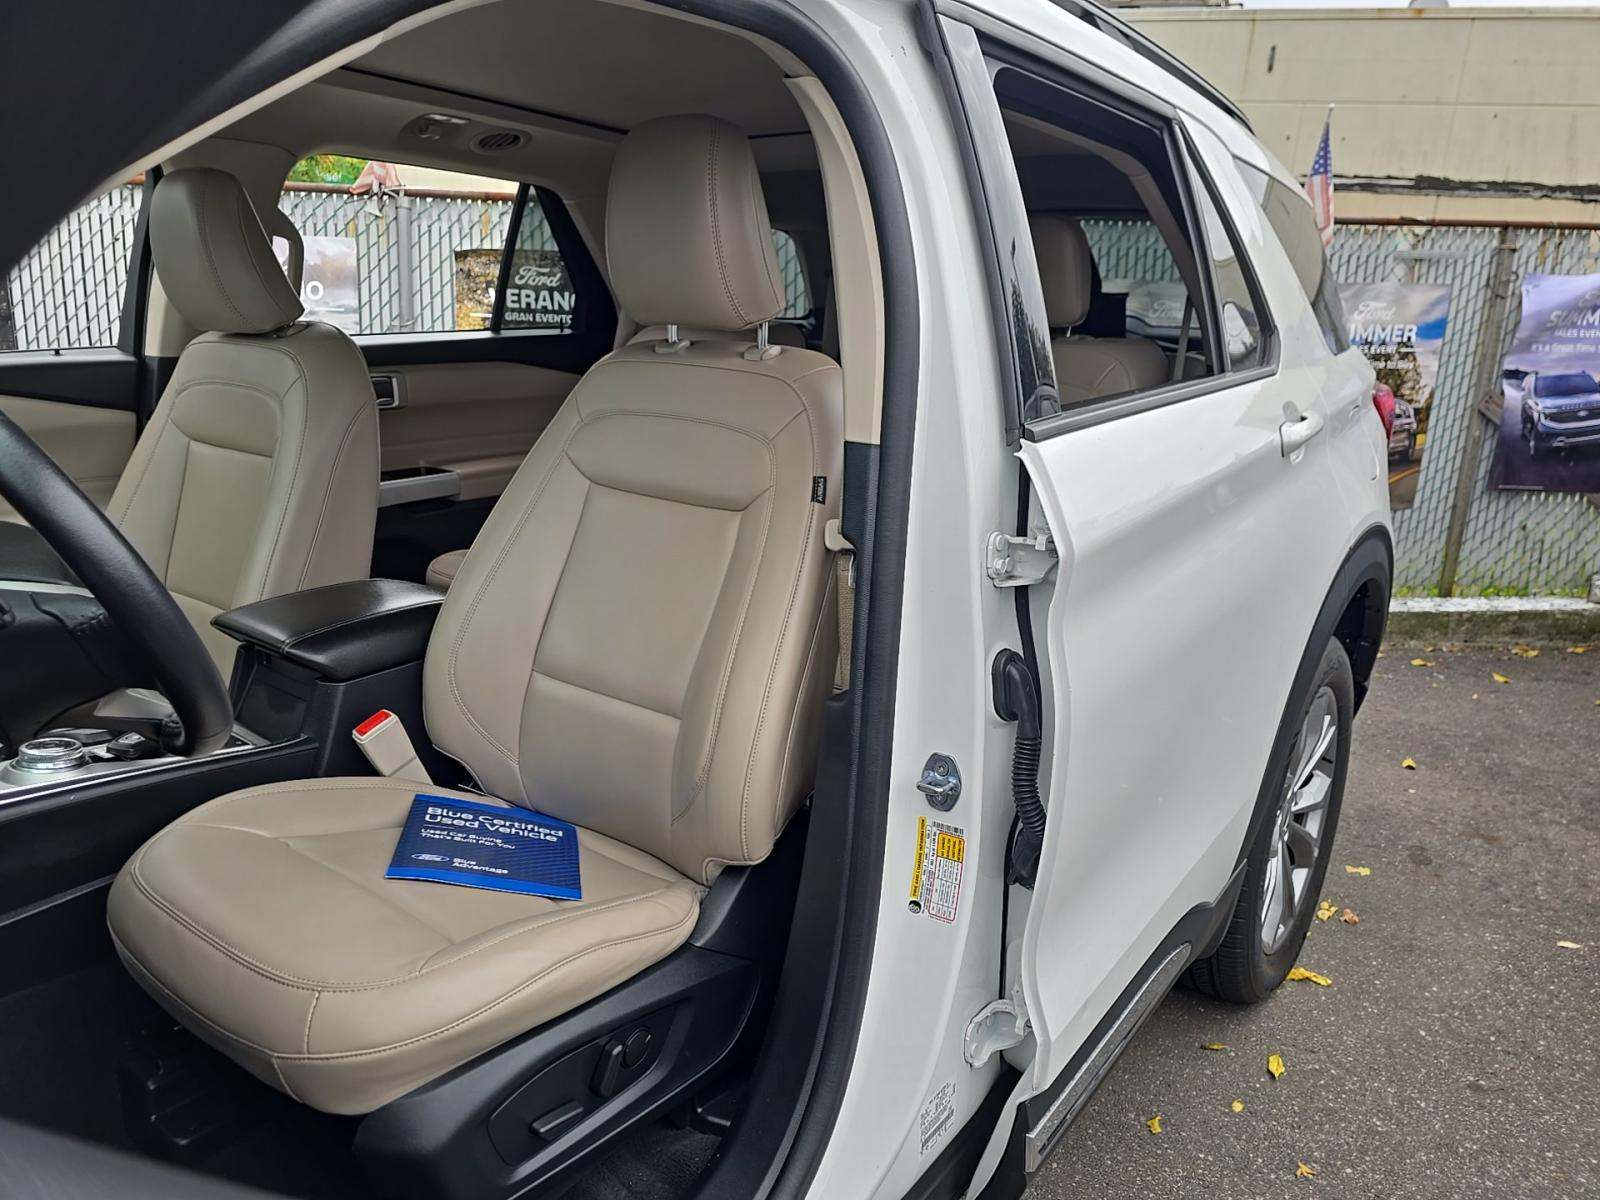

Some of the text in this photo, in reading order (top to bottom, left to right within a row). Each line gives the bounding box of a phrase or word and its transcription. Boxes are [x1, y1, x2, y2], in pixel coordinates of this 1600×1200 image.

[514, 265, 562, 287] Ford
[505, 288, 576, 311] ERAN
[504, 311, 534, 322] GRAN
[1349, 323, 1418, 344] MMER
[421, 828, 448, 836] Used
[424, 814, 558, 843] Used Vehicle
[427, 806, 564, 837] Blue Certified
[451, 862, 510, 875] Advantage
